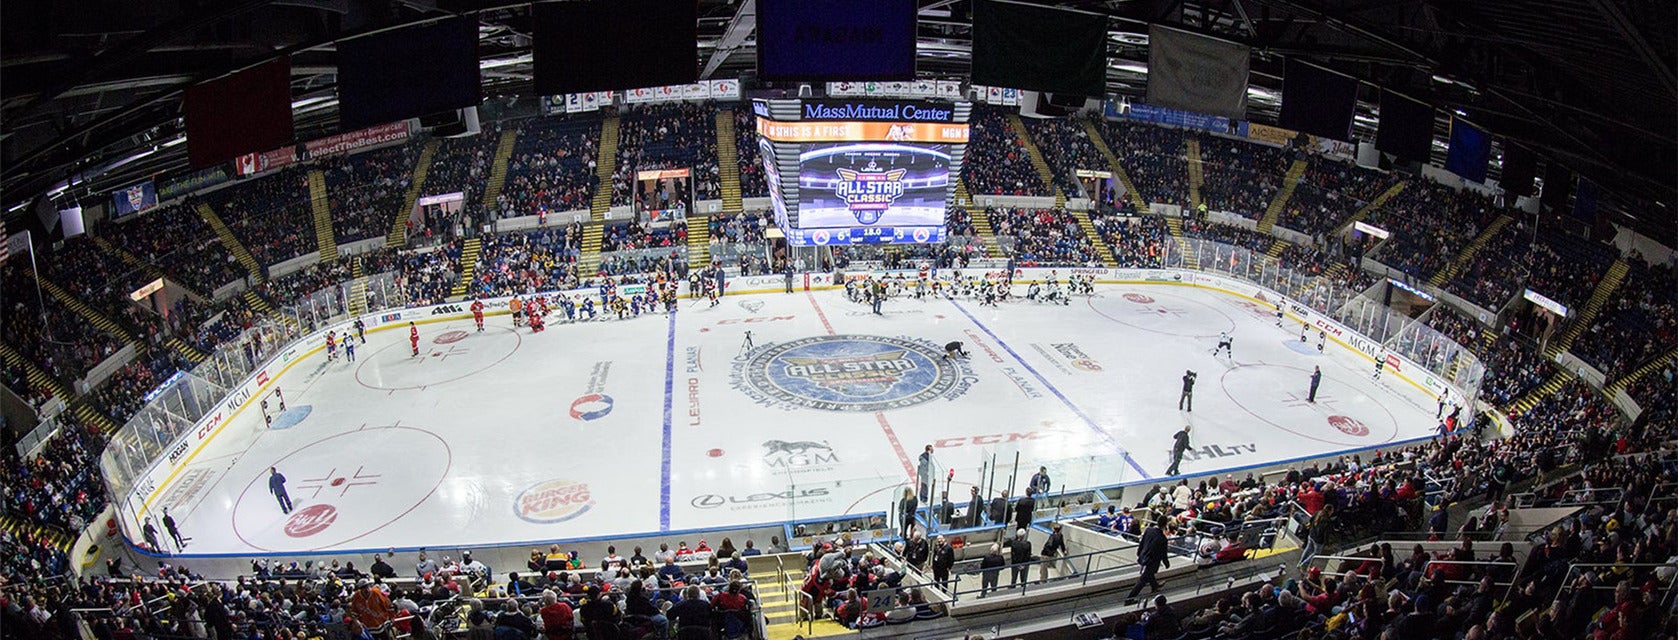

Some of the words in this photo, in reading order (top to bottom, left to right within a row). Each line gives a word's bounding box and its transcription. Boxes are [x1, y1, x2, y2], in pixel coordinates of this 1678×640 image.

[805, 104, 899, 119] MassMutual
[902, 105, 950, 120] Center
[848, 194, 892, 203] CLASSIC
[1070, 267, 1109, 275] SPRINGFIELD
[1316, 319, 1343, 337] CCM
[1349, 334, 1376, 357] MGM
[686, 345, 698, 373] PLANAR
[227, 388, 251, 413] MGM
[688, 377, 701, 427] LEYARD
[198, 413, 222, 440] CCM
[934, 431, 1039, 448] CCM
[168, 440, 190, 463] HOGAN
[763, 452, 840, 468] MGM
[523, 483, 590, 504] BURGER
[729, 487, 830, 504] LEXUS
[523, 491, 591, 517] KING
[872, 595, 892, 609] 24
